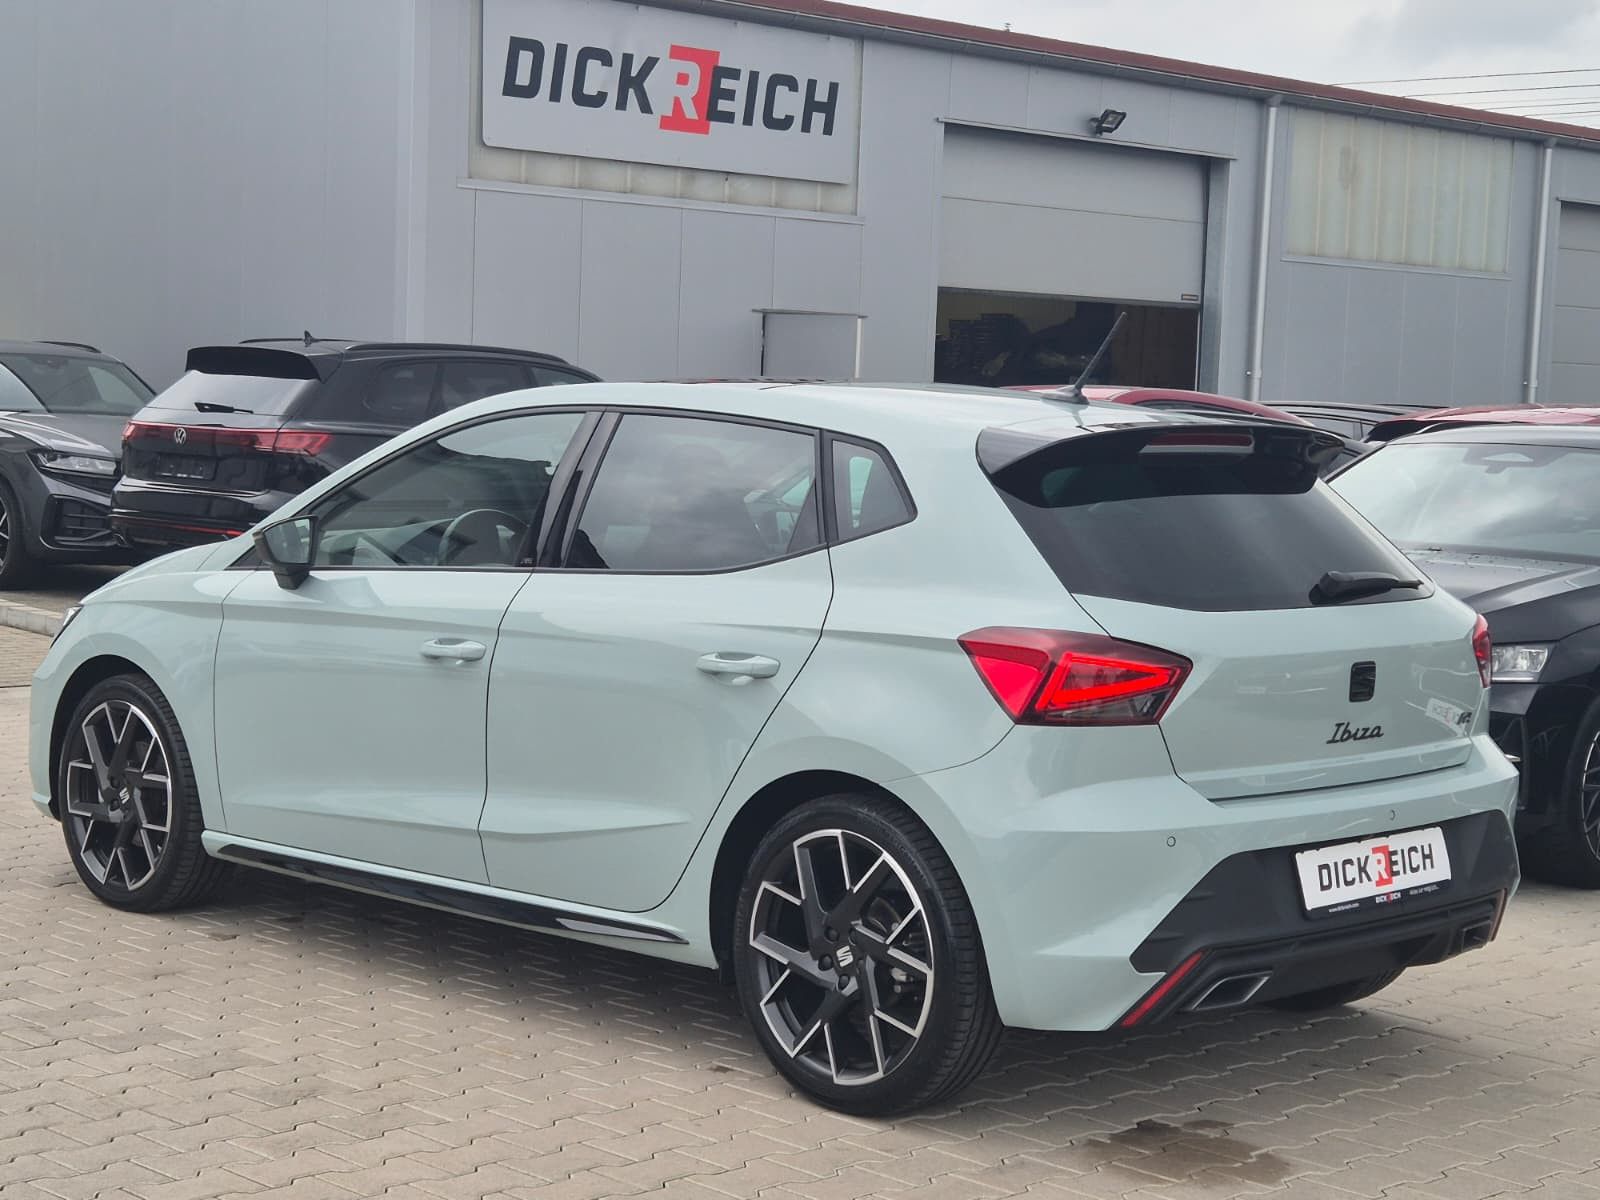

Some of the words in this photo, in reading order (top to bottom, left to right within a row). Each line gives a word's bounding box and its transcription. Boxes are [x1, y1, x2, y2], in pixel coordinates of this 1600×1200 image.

[502, 36, 839, 136] DICKREICH
[1326, 722, 1384, 744] Ibiza
[1318, 843, 1435, 891] DICKREICH
